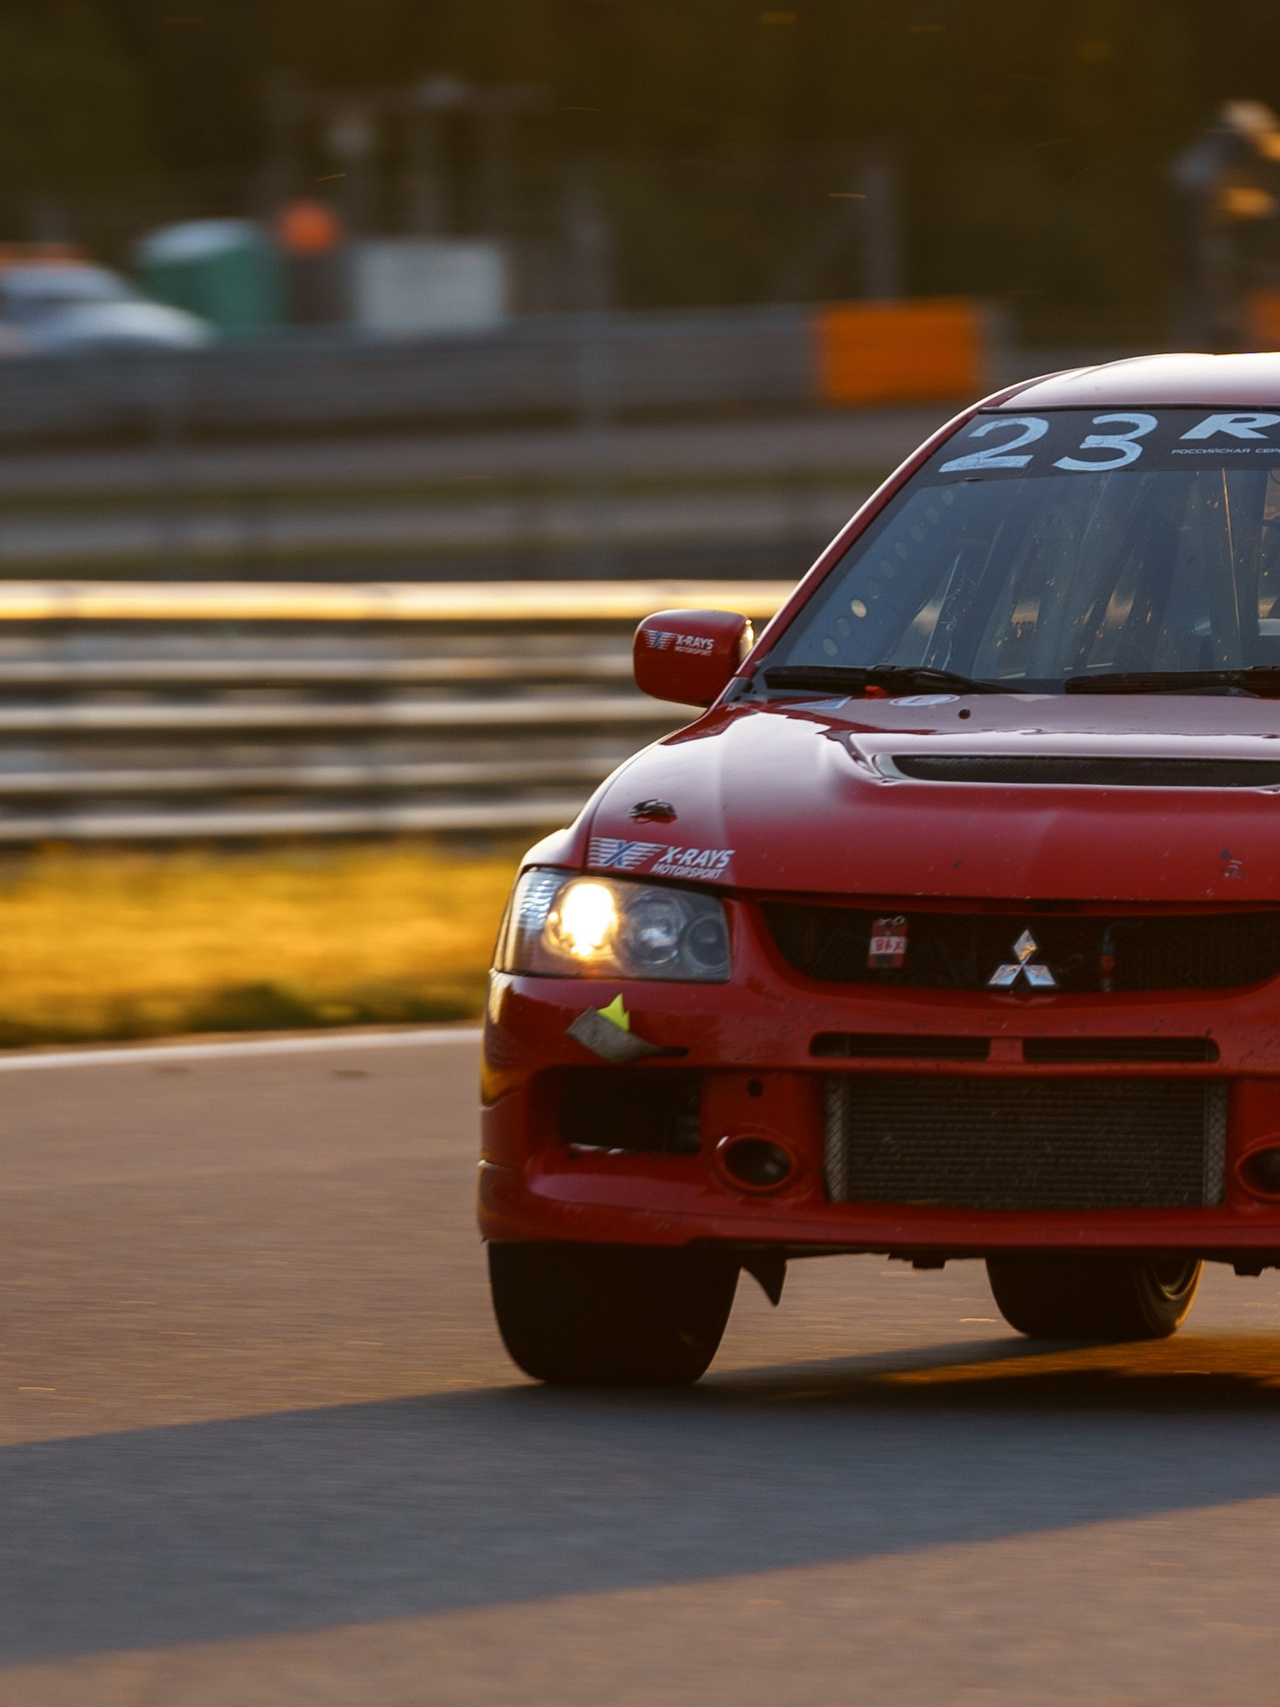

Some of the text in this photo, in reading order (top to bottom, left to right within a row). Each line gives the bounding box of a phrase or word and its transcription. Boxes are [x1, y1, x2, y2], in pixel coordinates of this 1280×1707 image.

[938, 413, 1158, 472] 23
[1171, 447, 1251, 455] РОССИЙСКАЯ
[675, 633, 714, 650] X-RAYS
[659, 846, 736, 868] X-RAYS
[650, 863, 725, 880] MOTORSPORT
